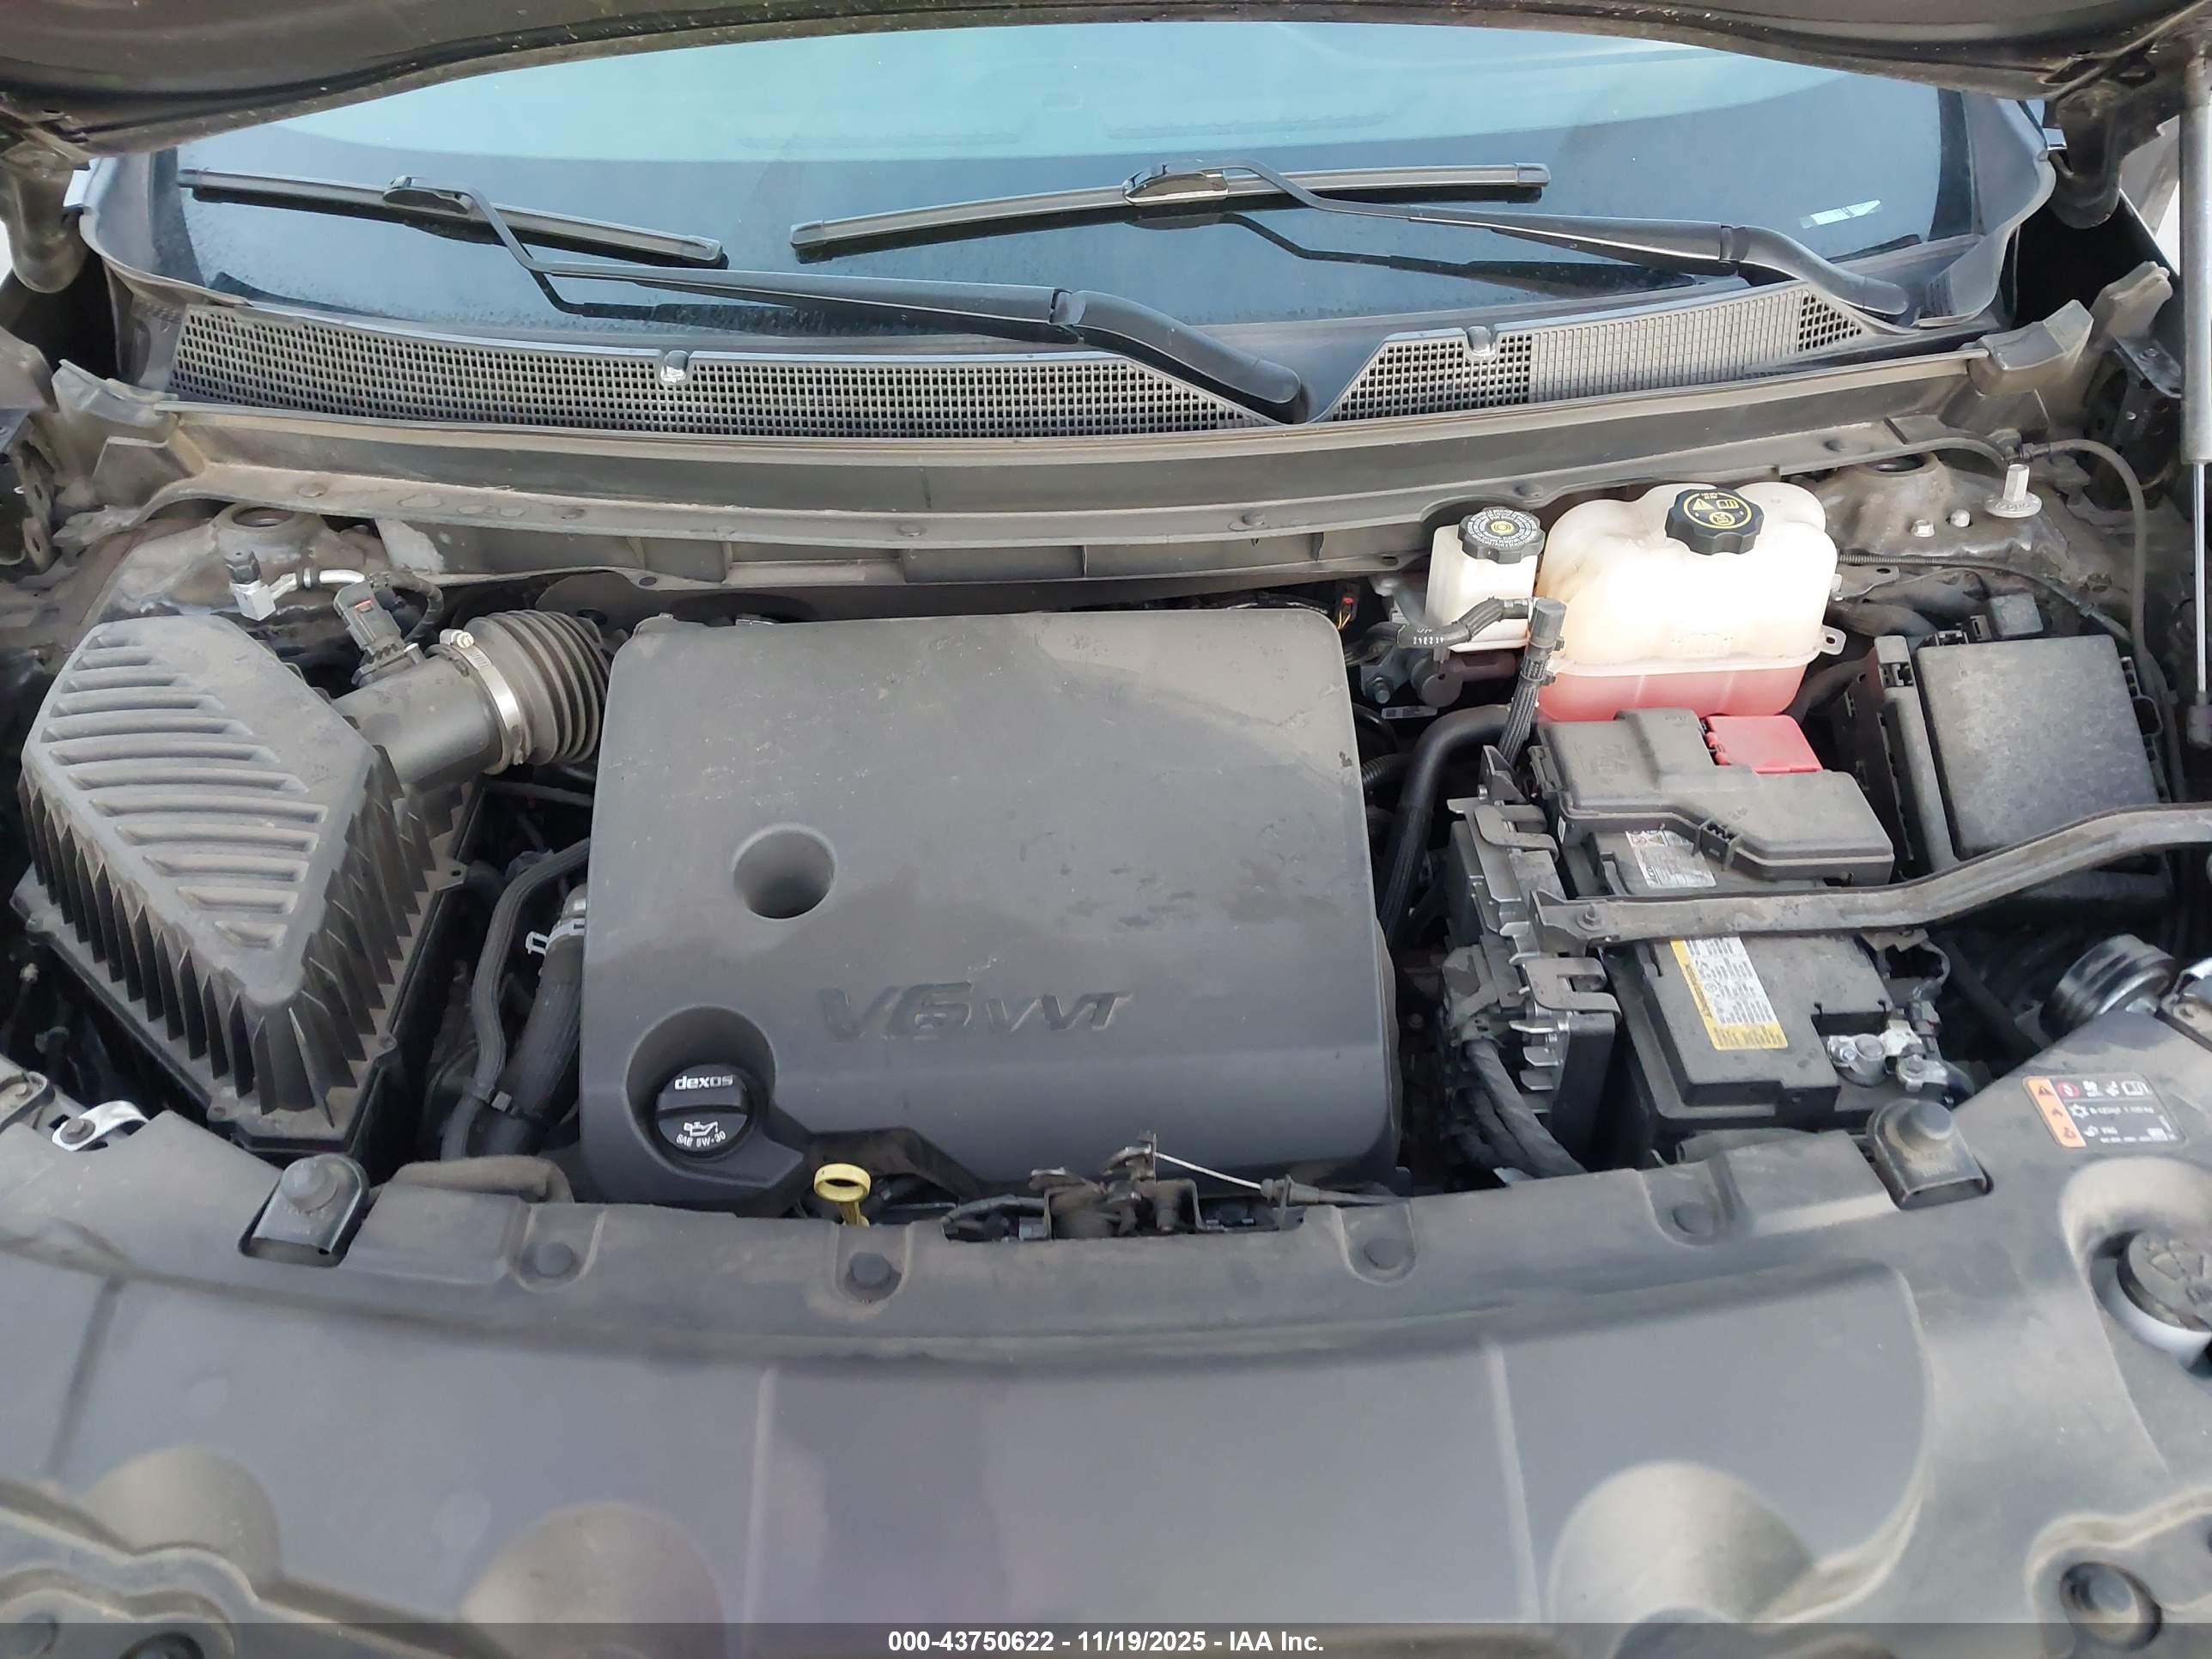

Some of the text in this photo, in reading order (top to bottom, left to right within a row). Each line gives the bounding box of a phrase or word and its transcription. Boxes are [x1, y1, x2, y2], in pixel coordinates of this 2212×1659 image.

[818, 980, 1133, 1042] V6 VVT
[674, 1075, 734, 1091] dexos
